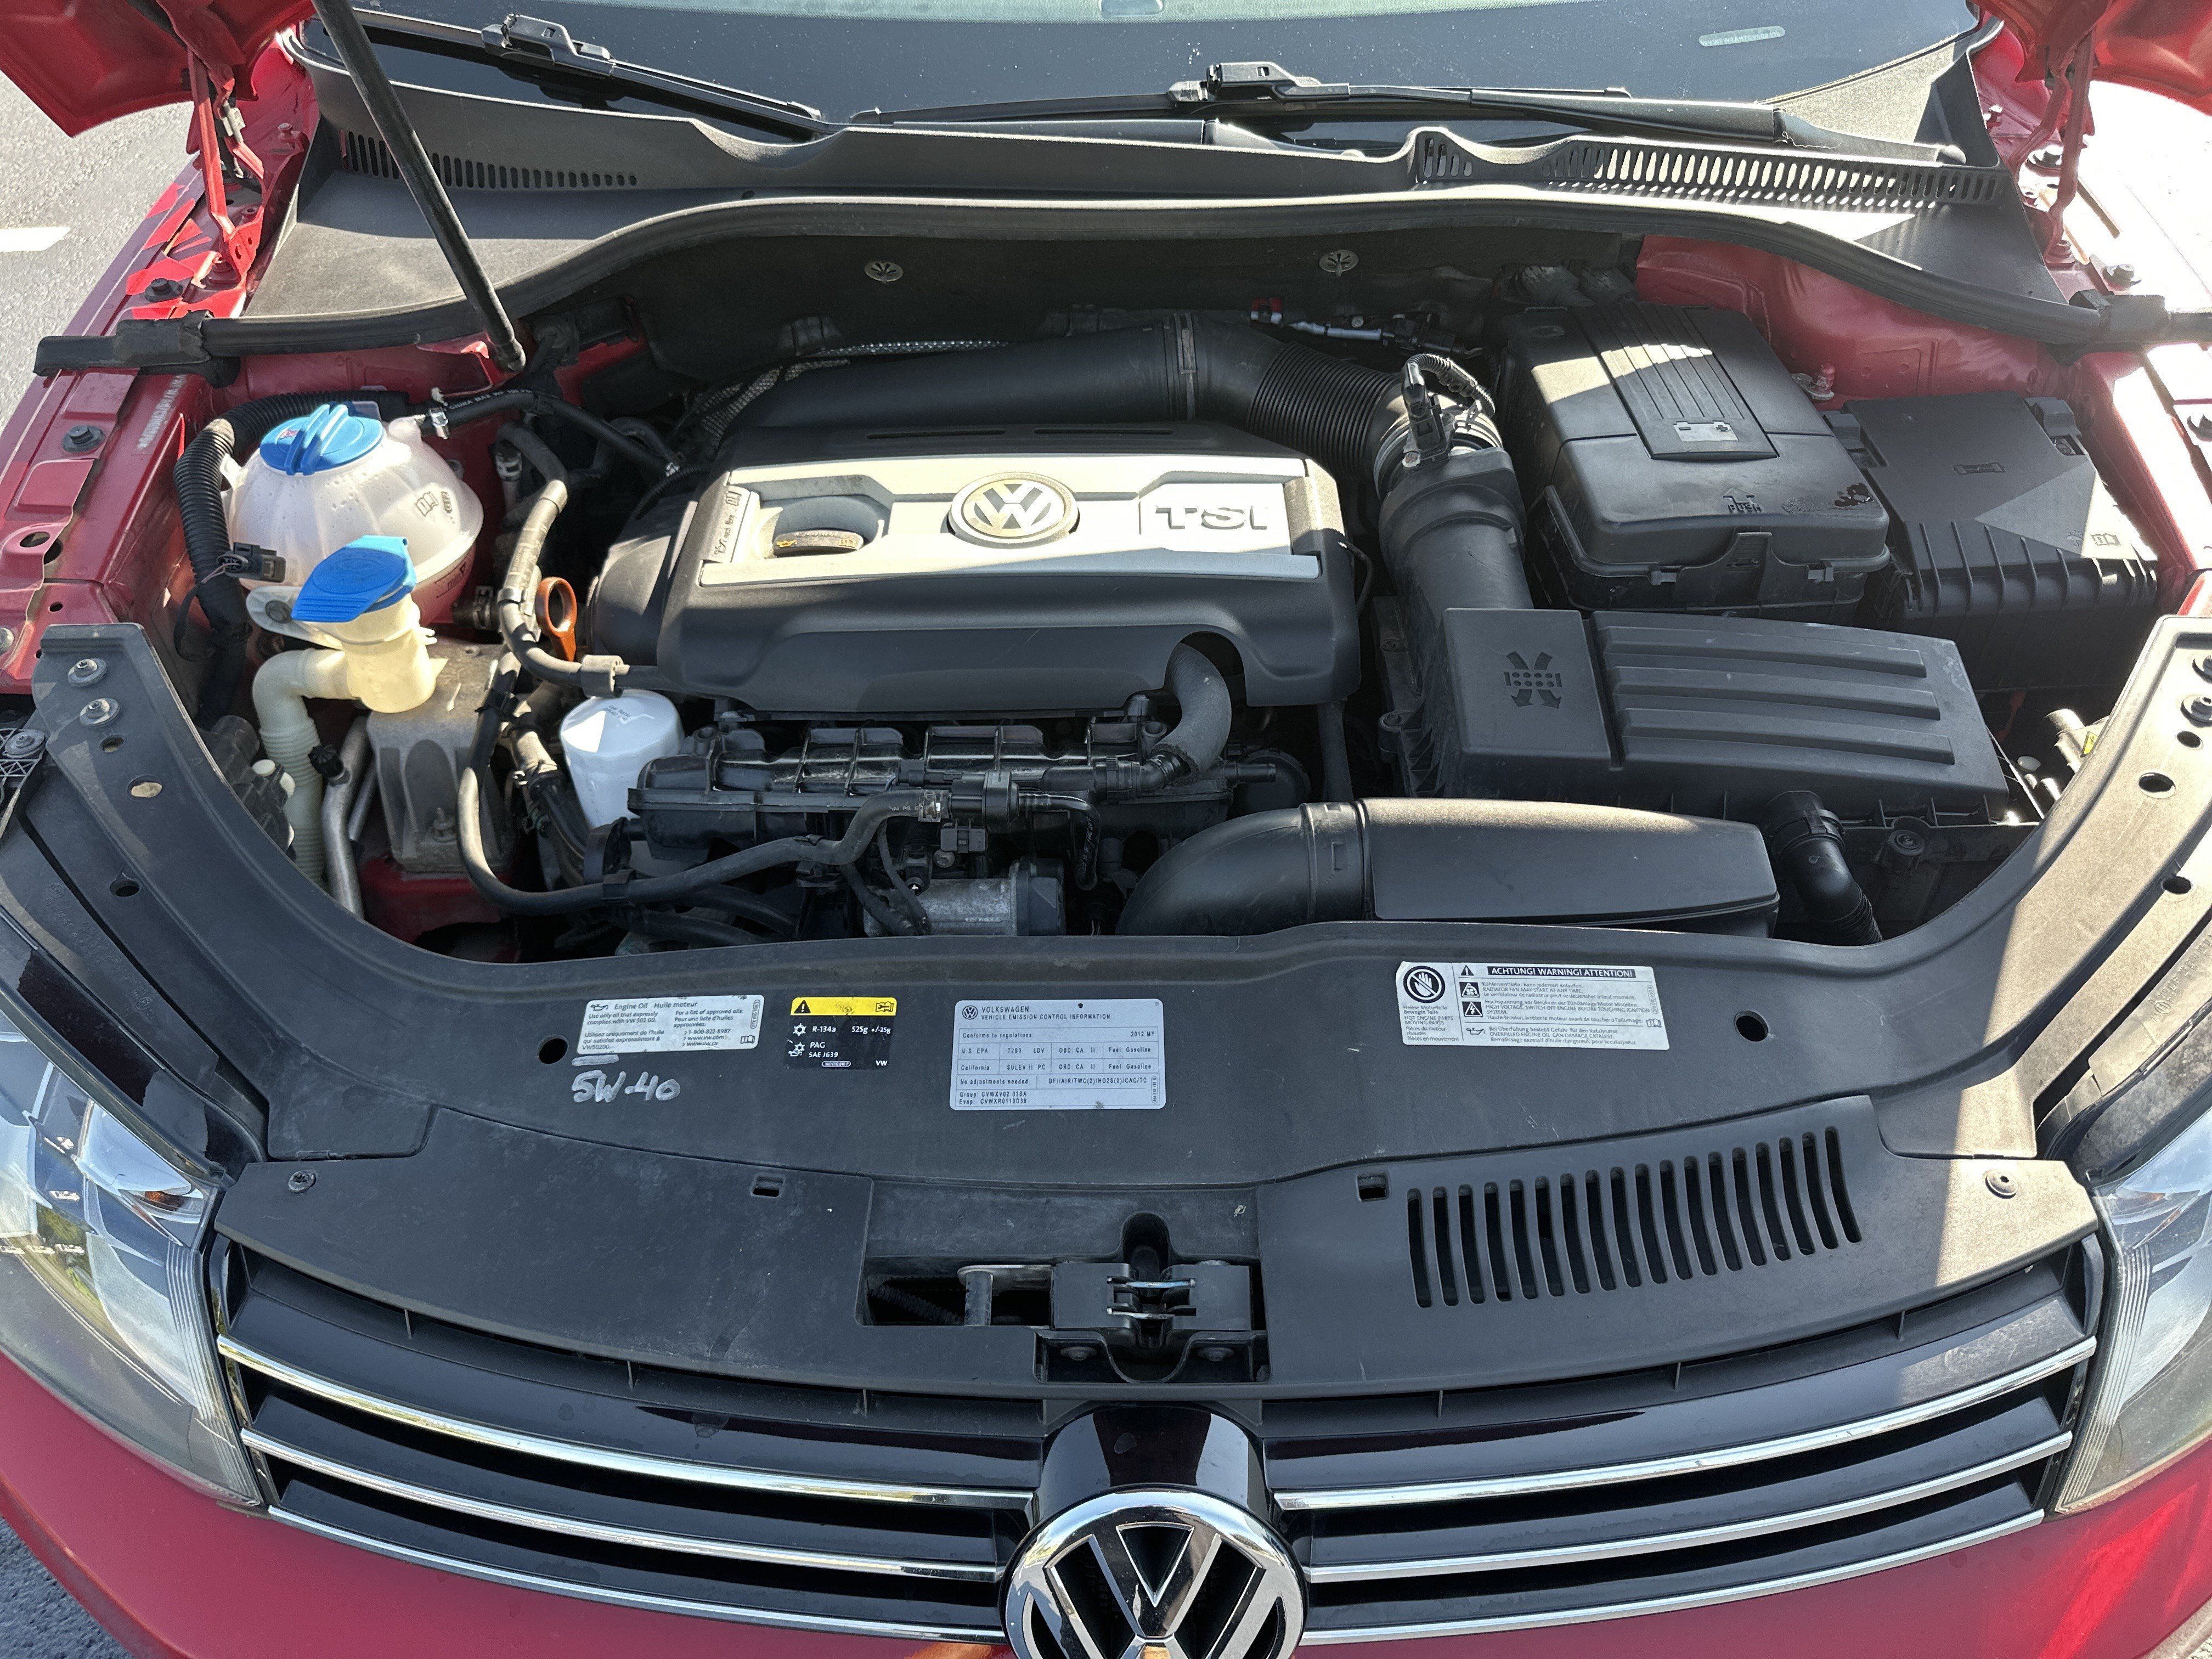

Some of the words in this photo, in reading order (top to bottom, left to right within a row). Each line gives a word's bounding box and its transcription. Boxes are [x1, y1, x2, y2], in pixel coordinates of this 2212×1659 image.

[1728, 504, 1762, 514] PUSH
[1155, 505, 1268, 530] TSI
[1491, 967, 1536, 975] ACHTUNG!
[1537, 968, 1582, 976] WARNING!
[1584, 969, 1633, 978] ATTENTION!
[851, 1026, 868, 1034] 525g
[871, 1026, 891, 1034] +/-25g
